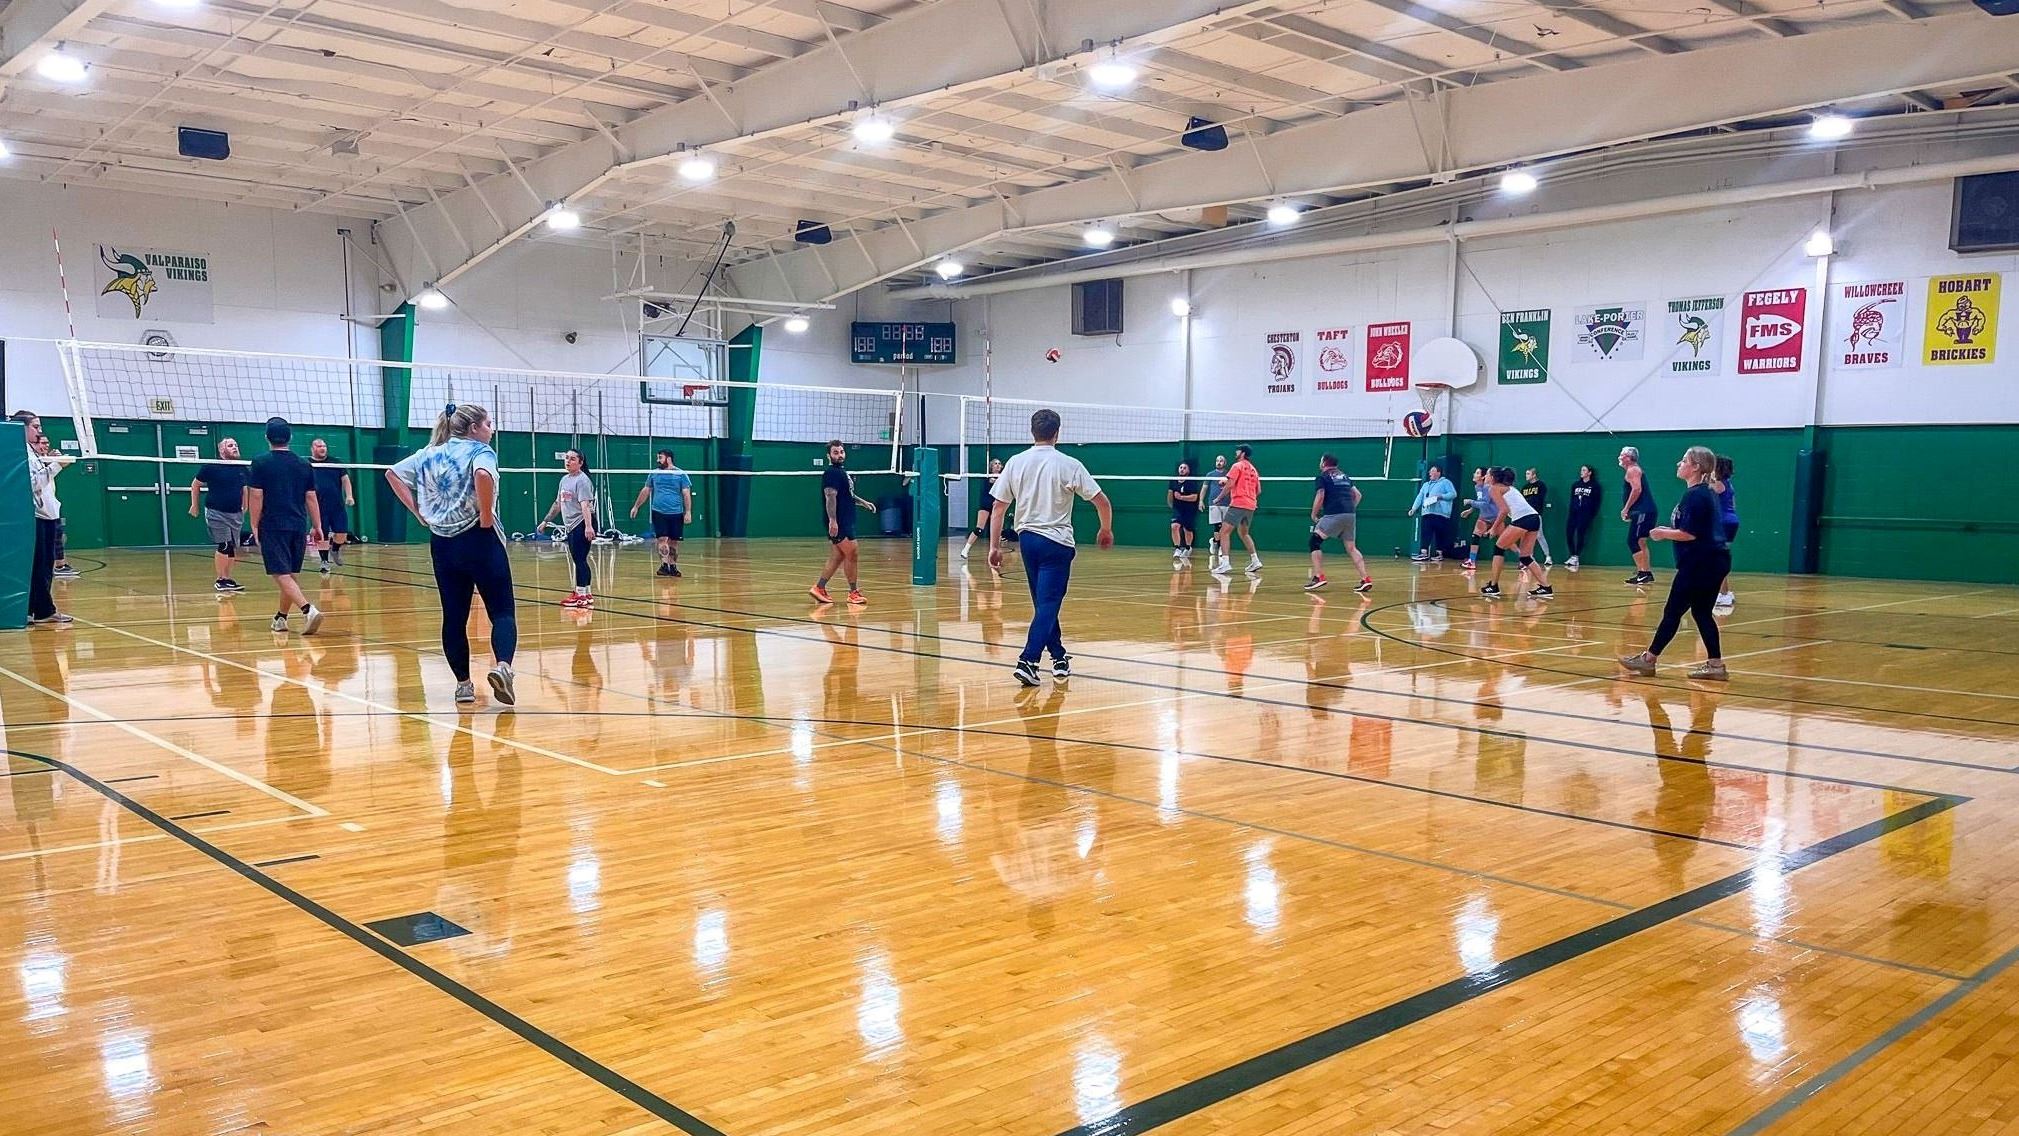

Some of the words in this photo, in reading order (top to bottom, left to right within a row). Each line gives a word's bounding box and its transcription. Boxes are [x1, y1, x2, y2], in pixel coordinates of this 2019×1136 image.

[145, 254, 207, 270] VALPARAISO
[166, 268, 208, 282] VIKINGS
[1844, 282, 1904, 298] WILLOWCREEK
[1938, 278, 1991, 293] HOBART
[1747, 290, 1799, 306] FEGELY
[1668, 300, 1691, 313] THOMAS
[1692, 297, 1724, 312] JEFFERSON
[1516, 310, 1549, 323] FRANKLIN
[1575, 311, 1644, 325] LAKE-PORTER
[1317, 330, 1348, 341] TAFT
[1590, 327, 1625, 337] CONFERENCE
[1750, 322, 1793, 338] FMS
[1267, 332, 1300, 344] CHESTERTON
[893, 352, 914, 360] perod
[1844, 353, 1888, 365] BRAVES
[1931, 348, 1986, 361] BRICKIES
[1672, 360, 1711, 371] VIKINGS
[1743, 356, 1797, 370] WARRIORS
[1506, 369, 1539, 380] VIKINGS
[1268, 384, 1295, 393] TROJANS
[1317, 380, 1348, 390] BULLDOGS
[1370, 377, 1404, 388] BULLDOGS
[156, 400, 171, 411] EXIT
